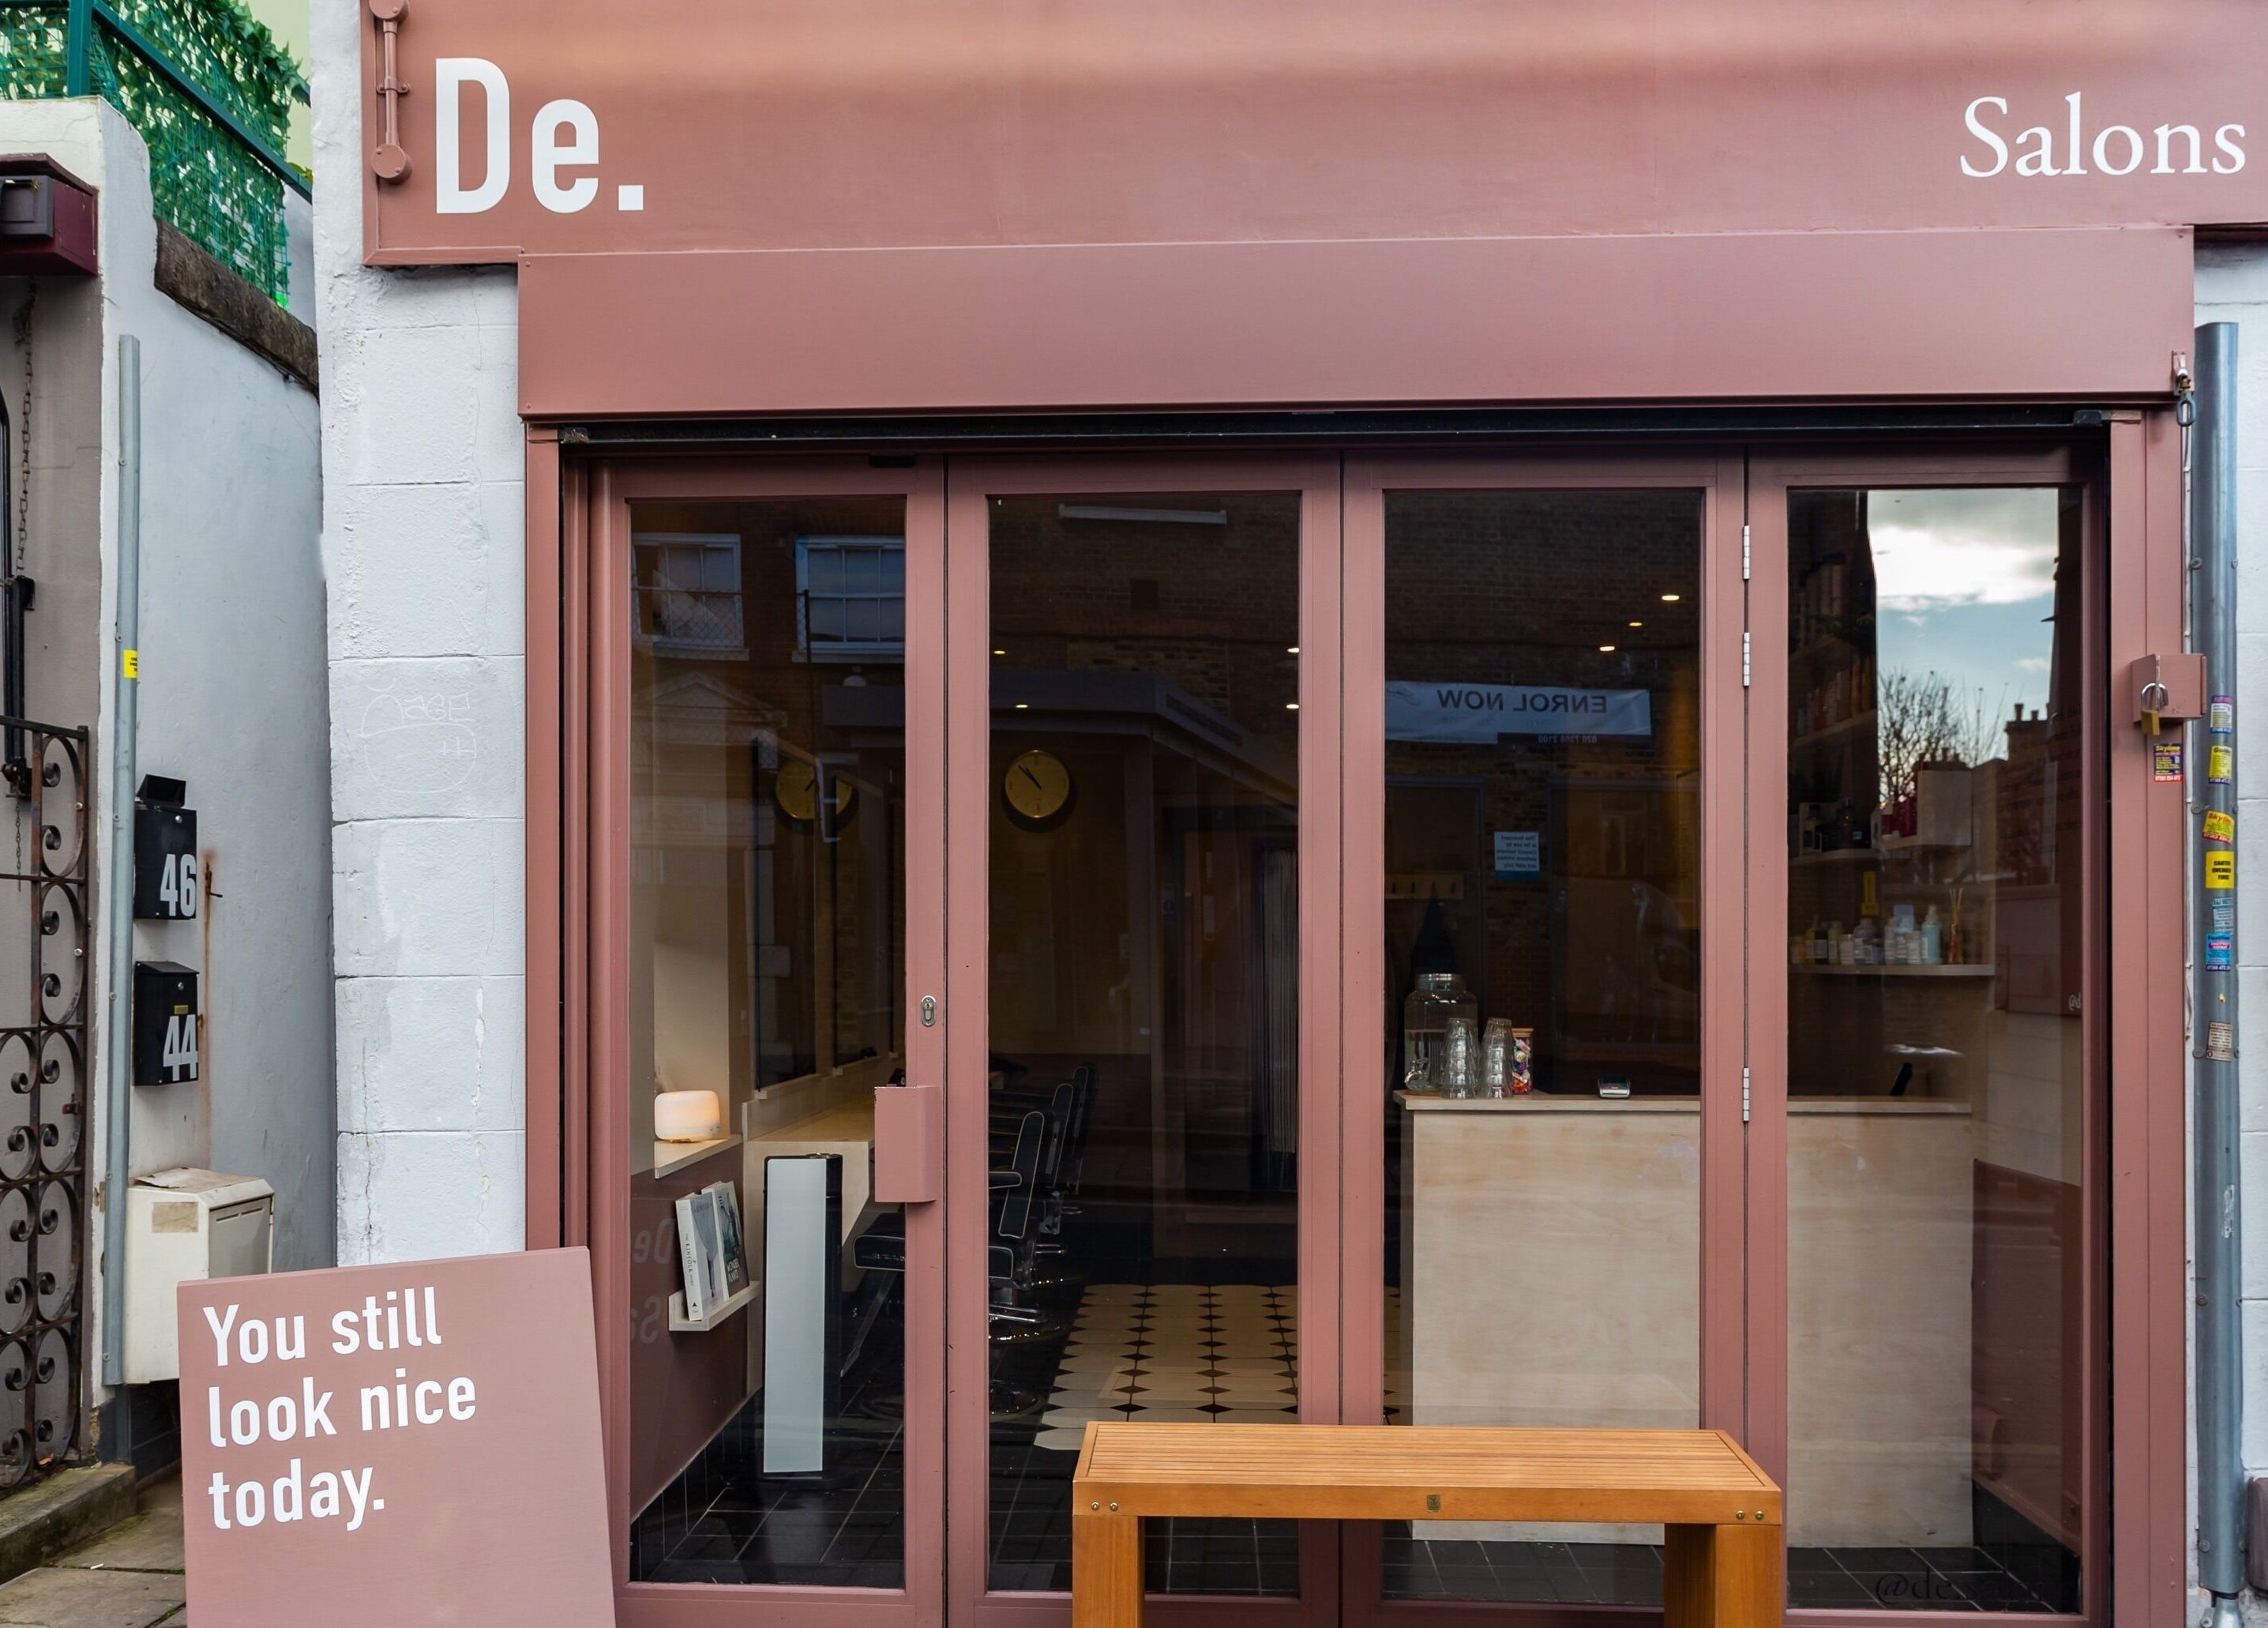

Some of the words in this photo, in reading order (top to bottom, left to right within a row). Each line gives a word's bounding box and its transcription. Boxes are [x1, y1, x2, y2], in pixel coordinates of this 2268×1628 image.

[436, 58, 644, 214] De.
[1960, 92, 2246, 178] Salons
[160, 854, 197, 916] 46
[163, 1014, 198, 1081] 44
[203, 1304, 306, 1367] You
[332, 1286, 442, 1355] still
[208, 1376, 336, 1447] look
[360, 1367, 476, 1431] nice
[208, 1458, 385, 1532] today.
